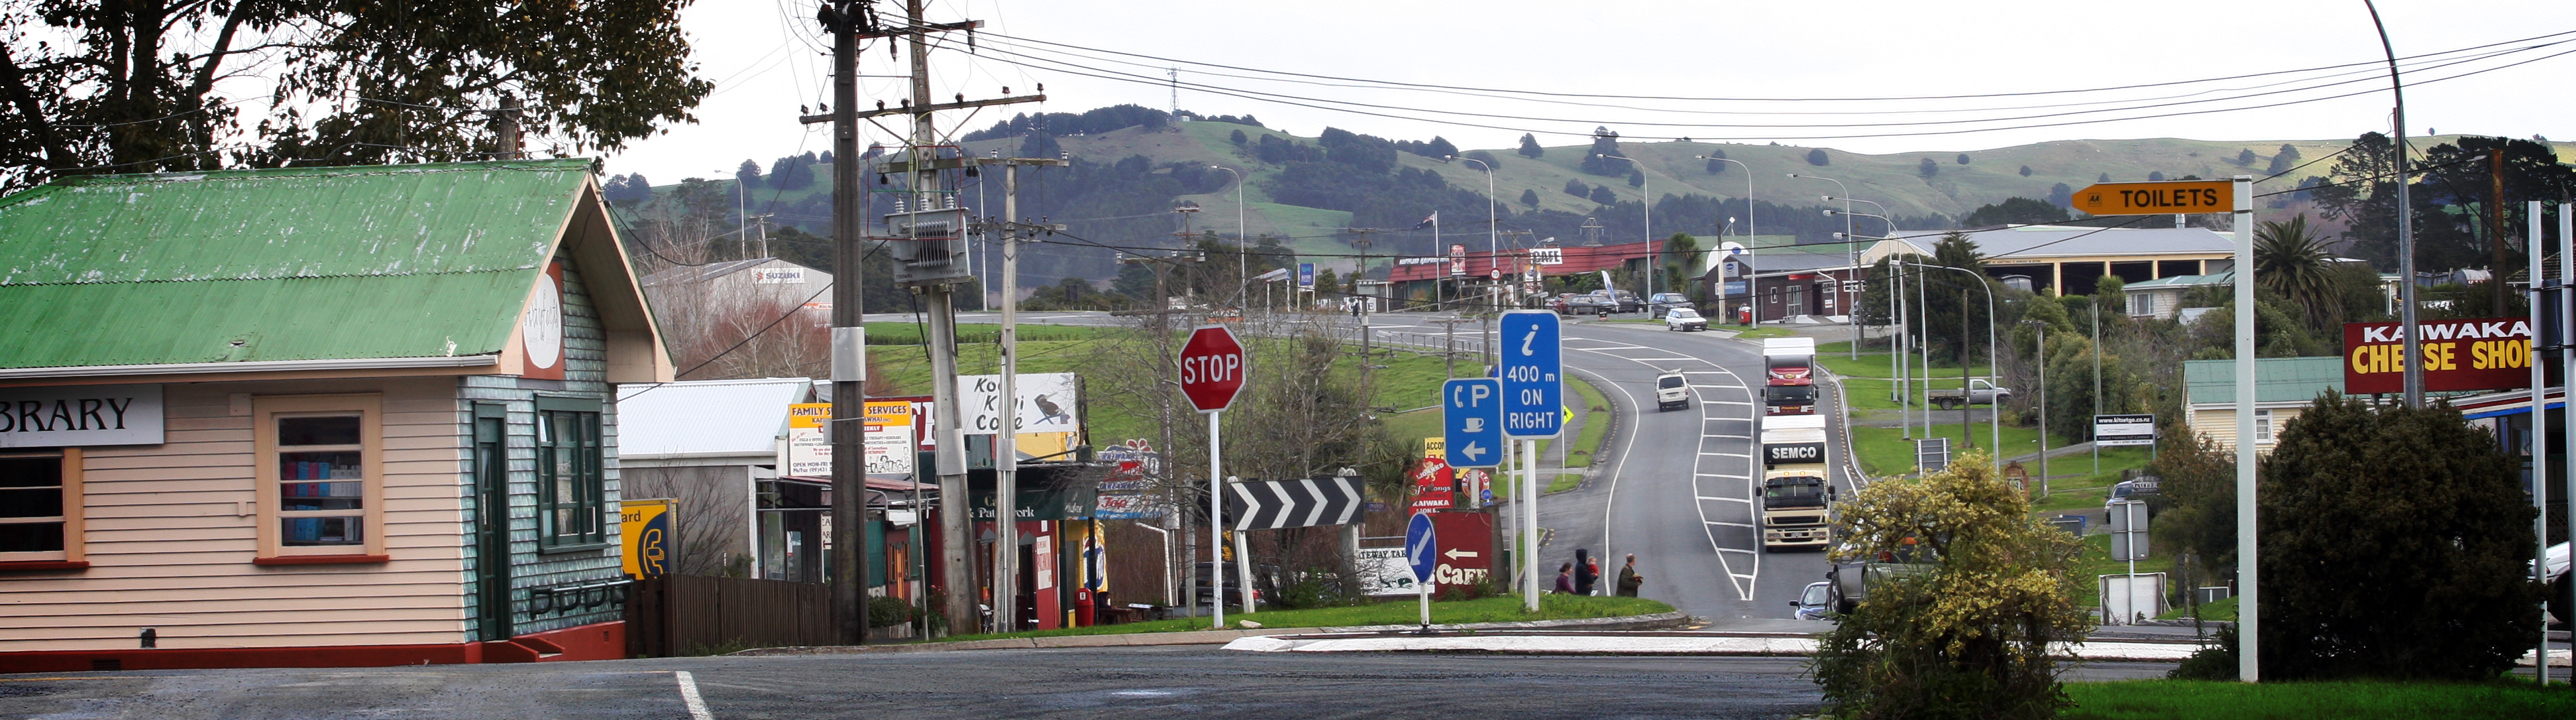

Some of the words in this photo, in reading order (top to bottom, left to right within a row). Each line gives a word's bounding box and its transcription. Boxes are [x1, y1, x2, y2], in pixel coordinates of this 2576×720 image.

[2120, 189, 2218, 208] TOILETS
[1533, 251, 1560, 263] CAFE
[2352, 343, 2457, 375] CHESE
[1185, 354, 1239, 385] STOP
[1507, 365, 1539, 382] 400
[1545, 373, 1555, 382] m
[984, 394, 1025, 412] Ki
[1472, 385, 1490, 408] P
[1521, 389, 1542, 406] ON
[792, 407, 824, 416] FAMILY
[868, 405, 907, 414] SERVICES
[1510, 412, 1554, 429] RIGHT
[1772, 446, 1817, 459] SEMCO
[978, 507, 1035, 518] Patork
